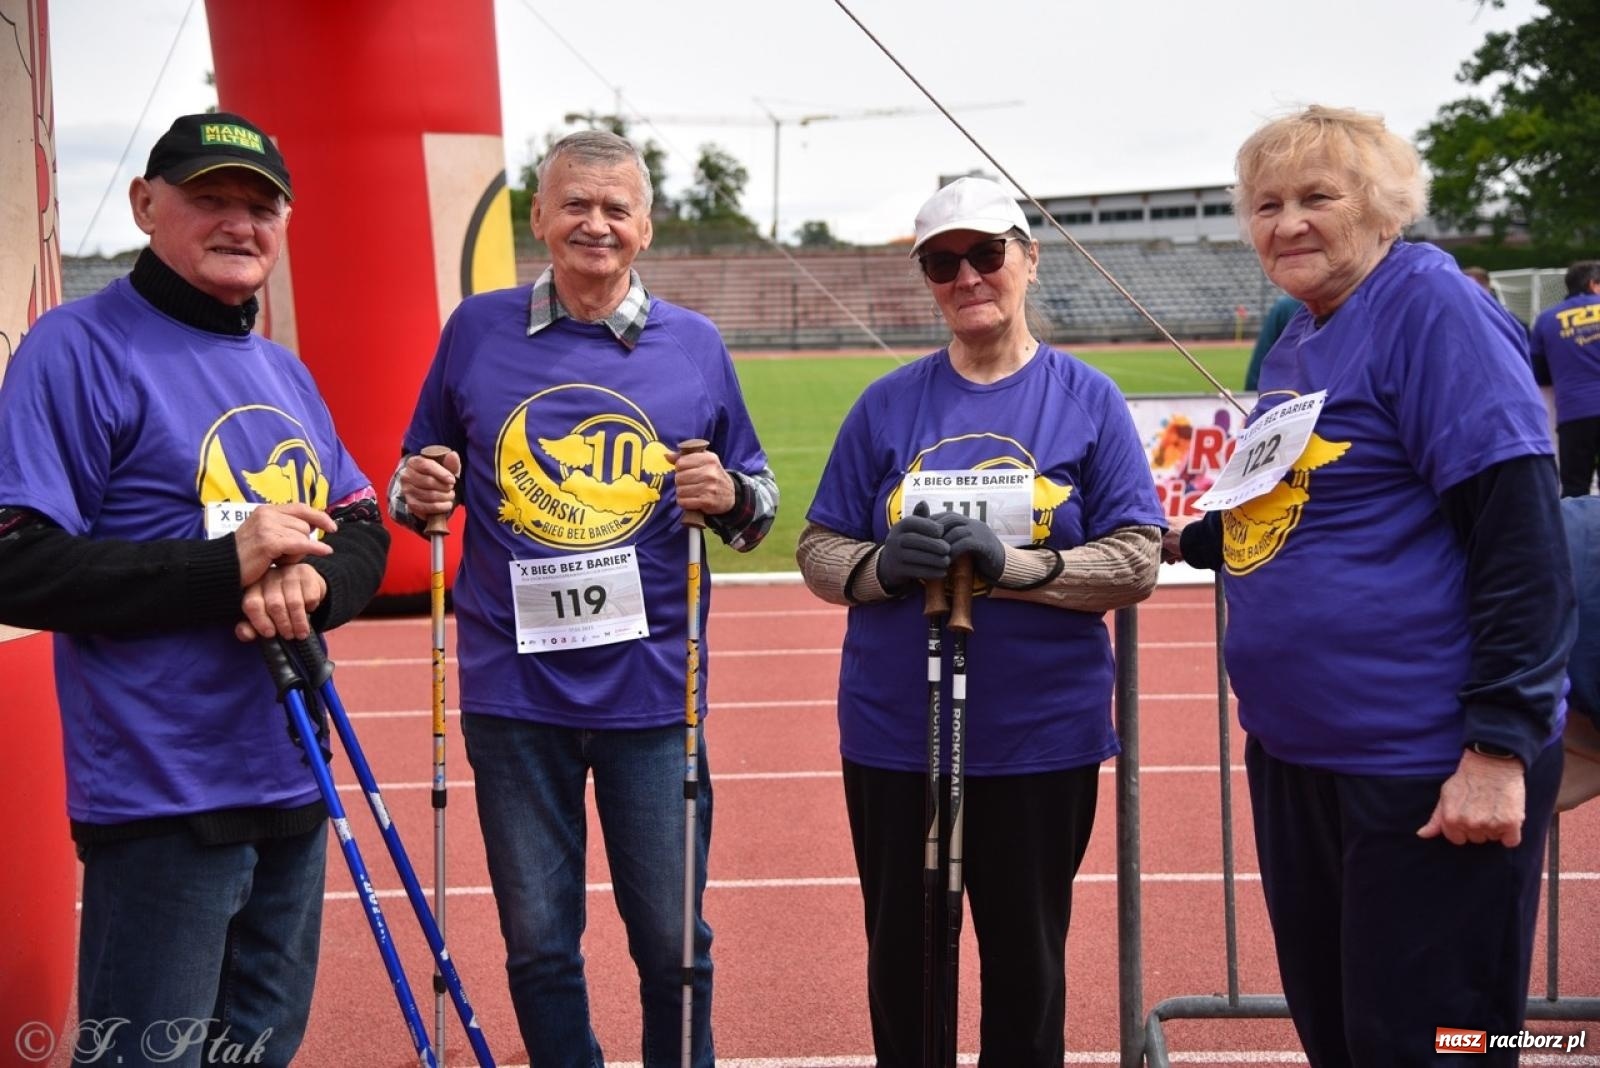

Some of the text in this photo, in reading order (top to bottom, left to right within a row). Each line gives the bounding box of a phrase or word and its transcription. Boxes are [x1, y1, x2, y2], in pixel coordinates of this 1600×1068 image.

[205, 125, 260, 142] MANN
[206, 134, 262, 151] FILTER
[1280, 399, 1315, 419] BARIER
[585, 430, 642, 485] 10
[1242, 433, 1282, 477] 122
[913, 474, 1024, 487] X BIEG BEZ BARIER
[507, 459, 586, 526] RACIBORSKI
[221, 510, 252, 521] X BI
[542, 518, 622, 540] BIEG BEZ BARIER
[520, 567, 528, 576] X
[531, 564, 557, 576] BIEG
[560, 561, 583, 573] BEZ
[587, 553, 628, 569] BARIER
[551, 584, 607, 619] 119
[952, 708, 961, 798] ROCKTRAIL
